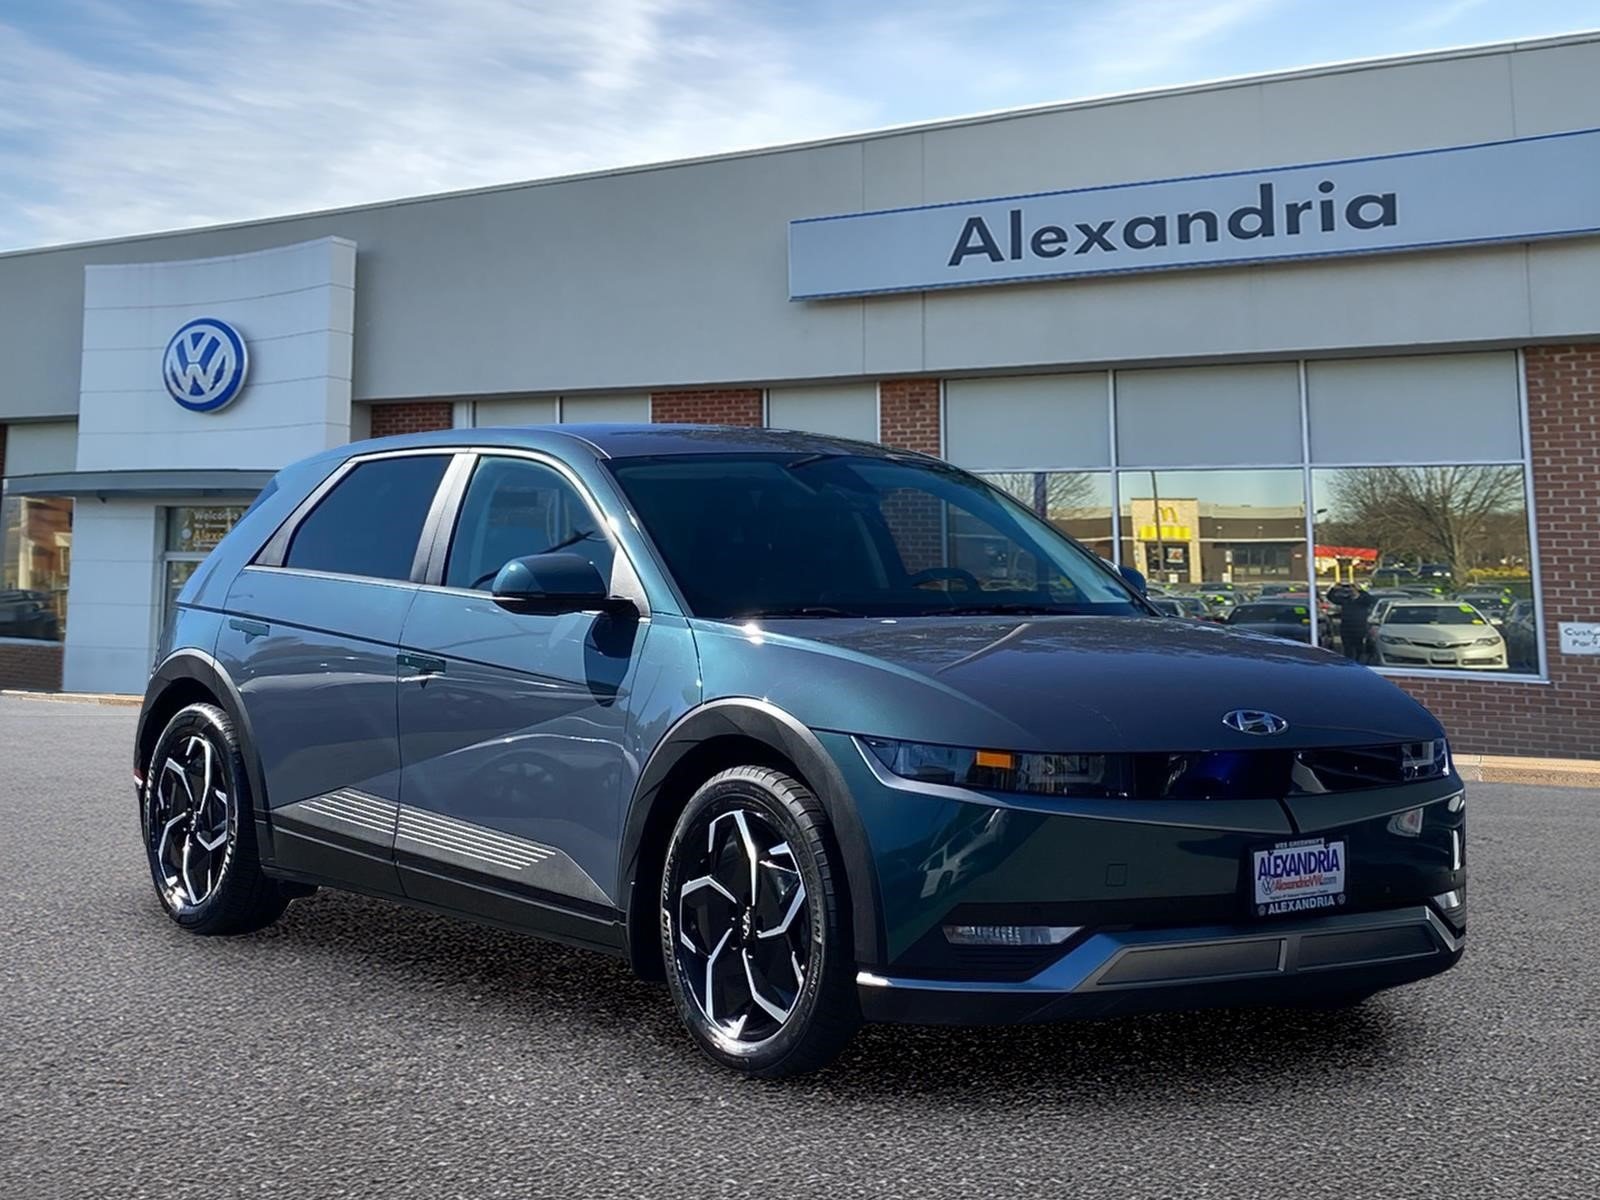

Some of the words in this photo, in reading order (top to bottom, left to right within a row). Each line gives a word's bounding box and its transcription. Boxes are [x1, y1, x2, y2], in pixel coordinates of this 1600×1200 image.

[948, 180, 1398, 268] Alexandria
[1257, 846, 1340, 880] ALEXANDRIA
[1267, 895, 1335, 915] ALEXANDRIA
